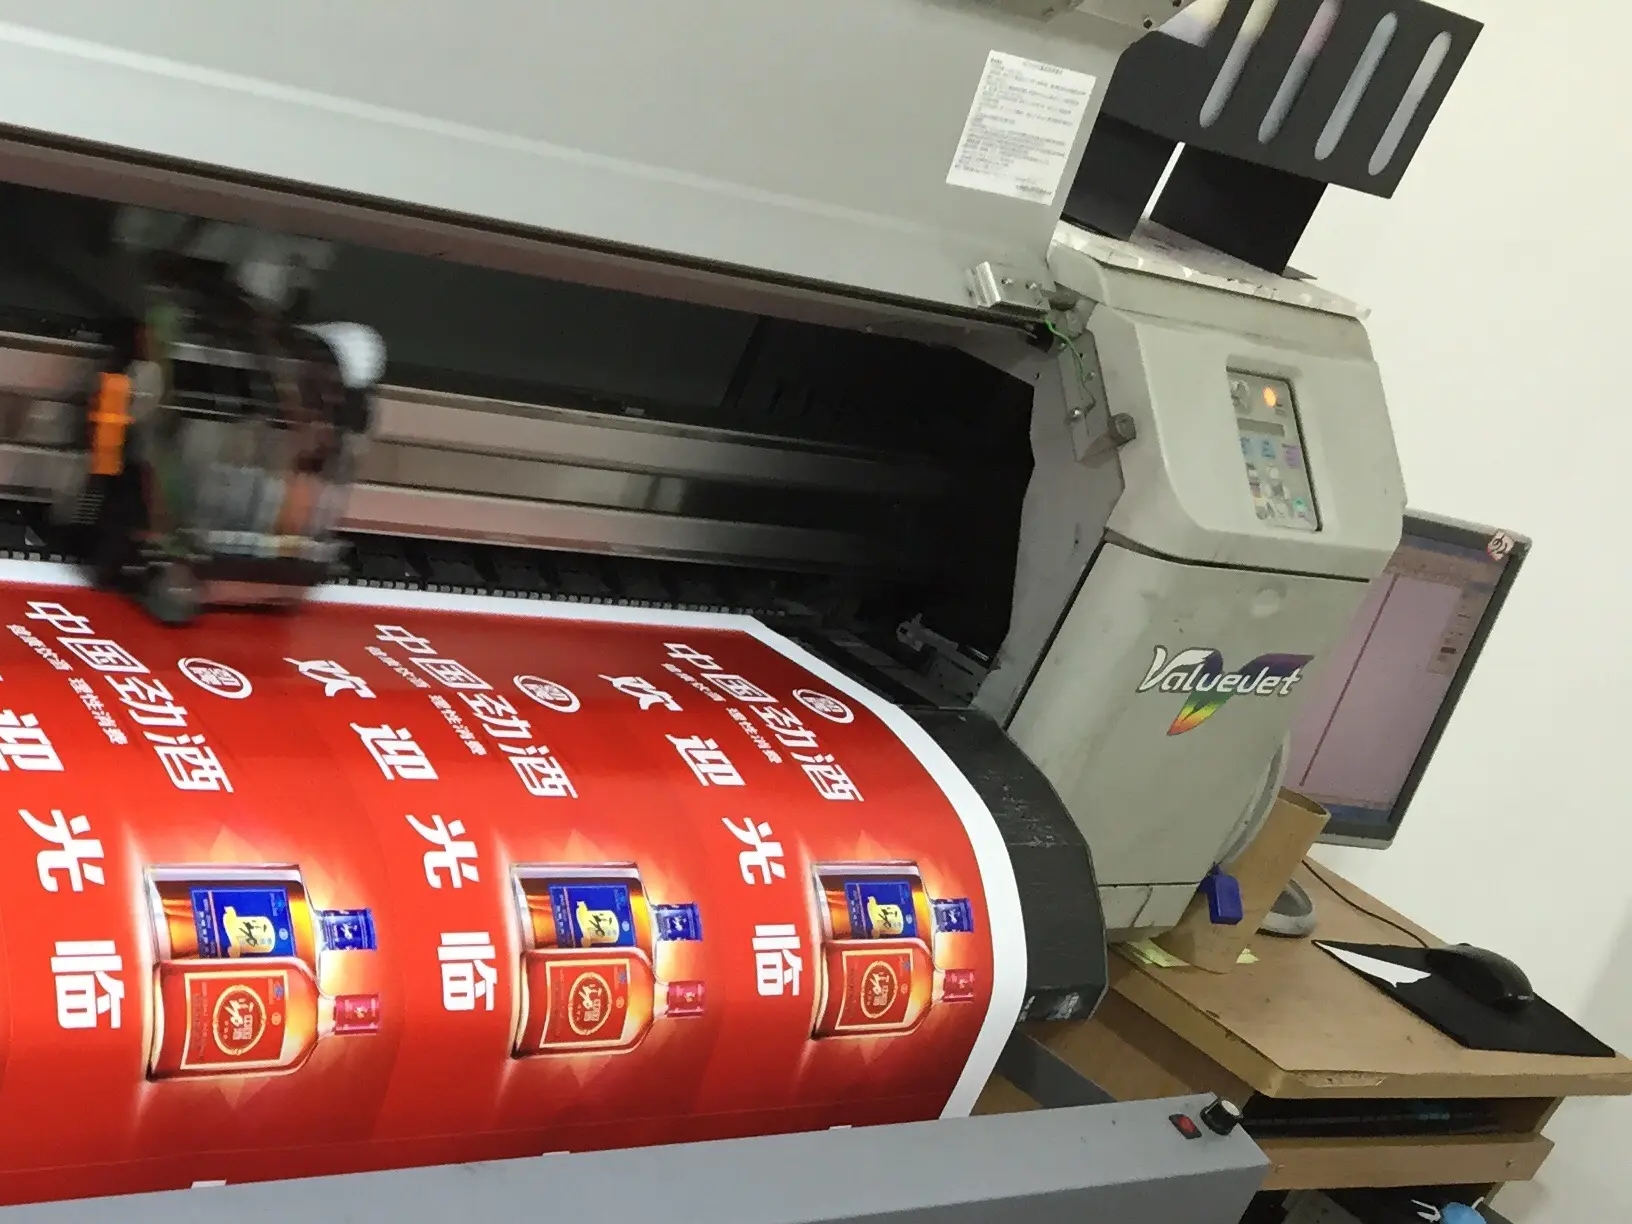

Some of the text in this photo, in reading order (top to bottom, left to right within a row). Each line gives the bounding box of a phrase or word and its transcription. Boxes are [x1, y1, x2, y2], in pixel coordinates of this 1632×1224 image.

[26, 602, 233, 792] 中国劲酒
[375, 625, 578, 798] 中国劲酒
[664, 643, 864, 800] 中国劲酒
[1137, 645, 1302, 696] ValueJet
[285, 658, 497, 1010] 欢迎光临
[600, 668, 802, 995] 欢迎光临
